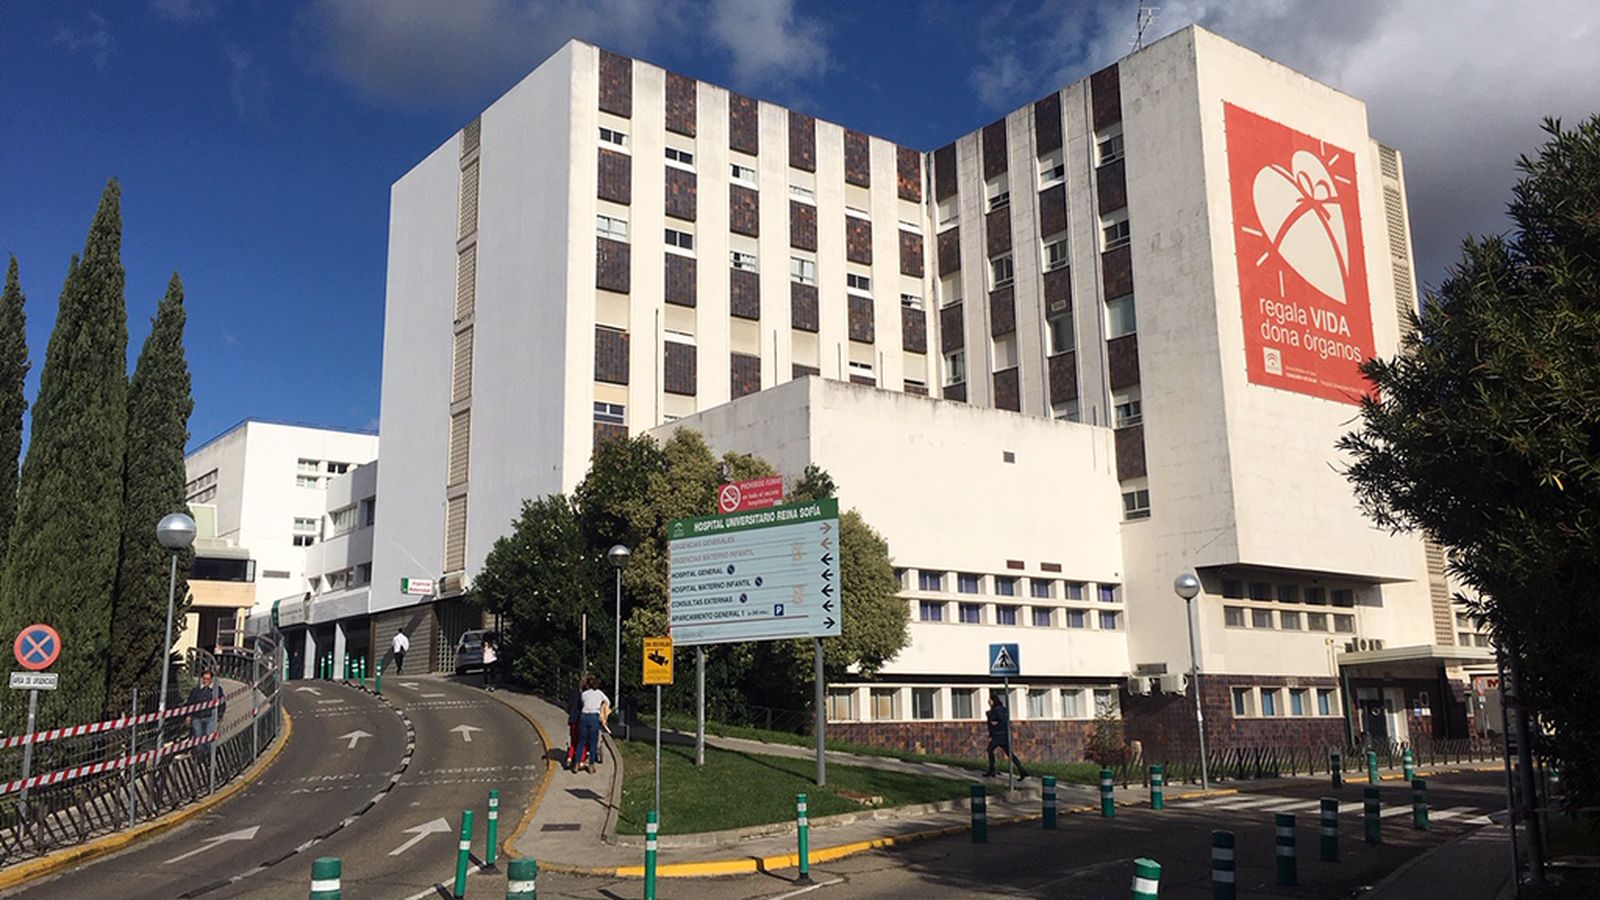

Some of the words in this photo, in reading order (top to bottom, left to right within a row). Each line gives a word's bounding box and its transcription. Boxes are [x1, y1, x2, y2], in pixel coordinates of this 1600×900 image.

[1259, 297, 1308, 325] regala
[1310, 306, 1351, 338] VIDA
[1261, 318, 1300, 347] dona
[1303, 329, 1362, 363] órganos
[694, 518, 724, 532] HOSPITAL
[725, 510, 775, 528] UNIVERSITARIO
[777, 507, 799, 520] REINA
[799, 503, 821, 517] SOFÍA
[702, 536, 735, 546] GENERALES
[672, 568, 697, 579] HOSPITAL
[698, 566, 723, 577] GENERAL
[672, 584, 697, 594] HOSPITAL
[698, 582, 726, 592] MATERNO
[726, 579, 751, 589] INFANTIL
[672, 598, 703, 609] CONSULTAS
[704, 596, 733, 606] EXTERNAS
[672, 612, 713, 622] APARCAMIENTO
[714, 610, 740, 620] GENERAL
